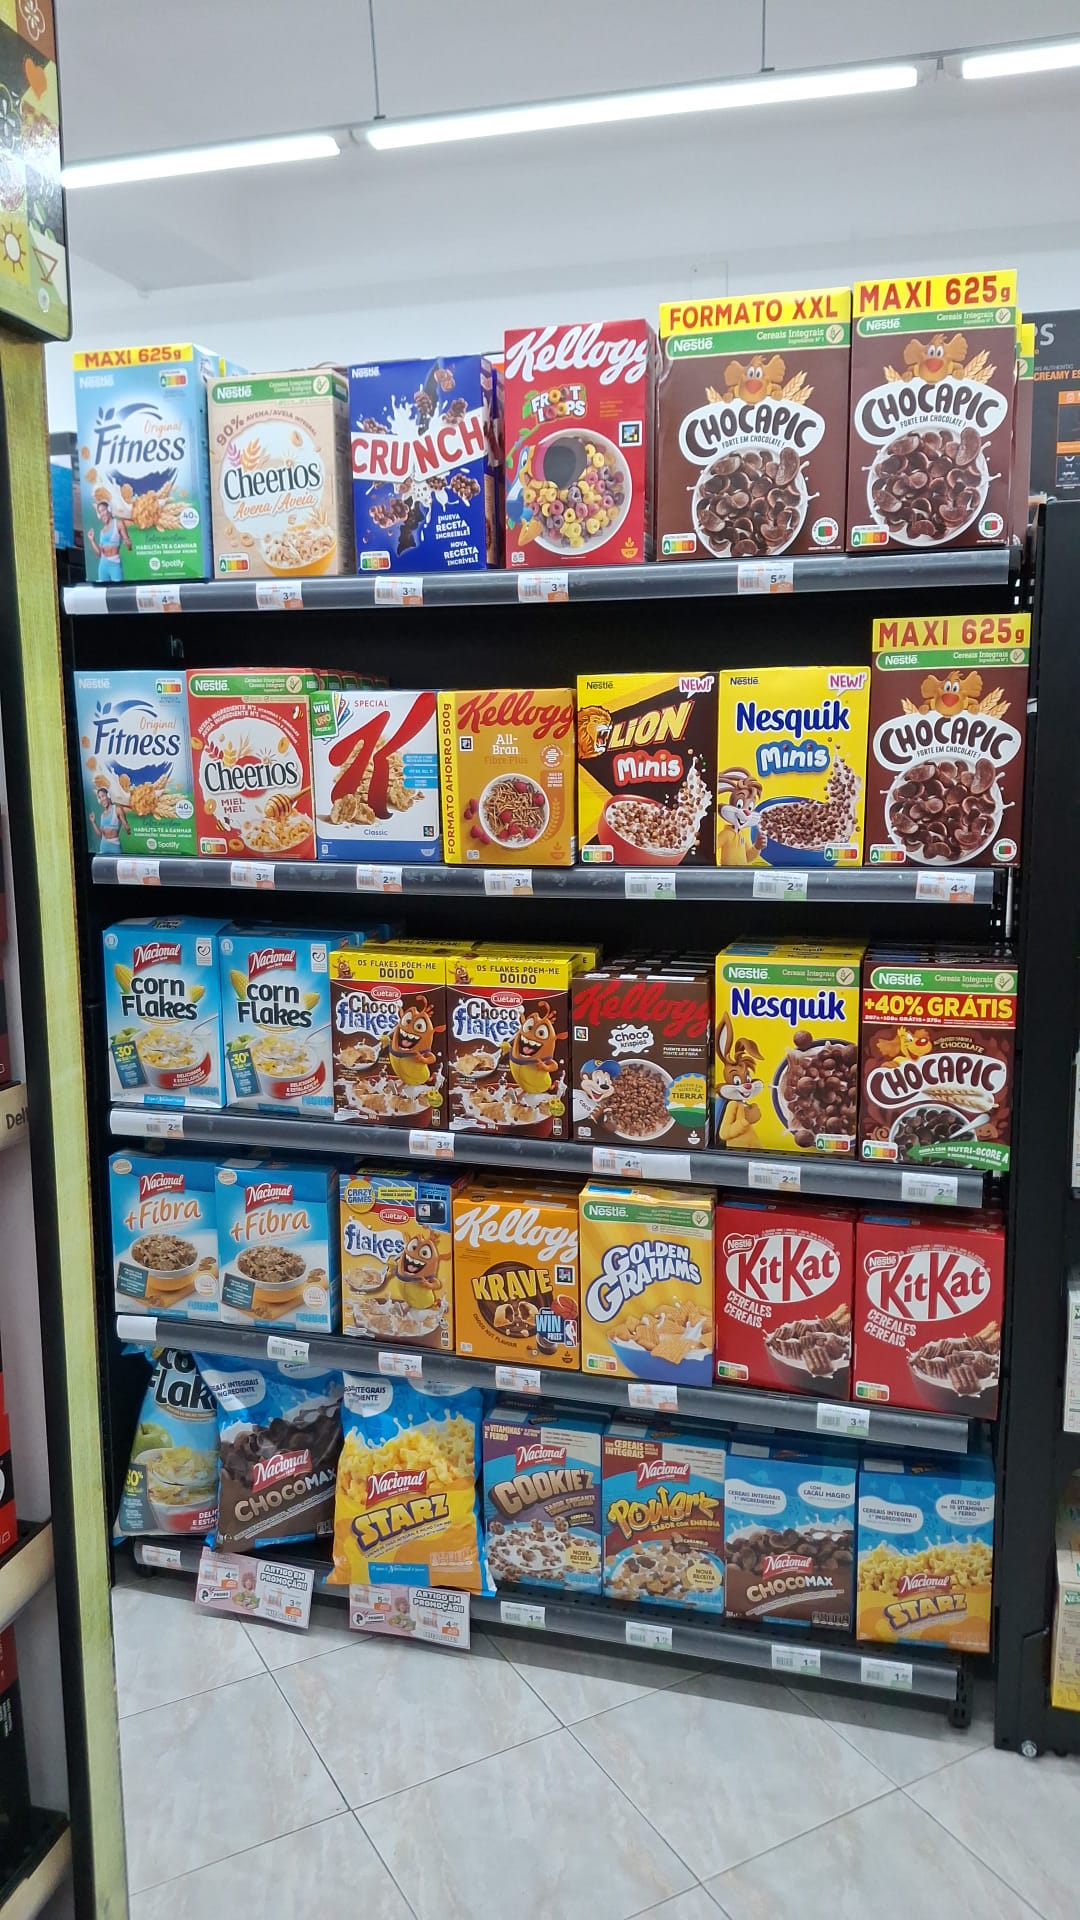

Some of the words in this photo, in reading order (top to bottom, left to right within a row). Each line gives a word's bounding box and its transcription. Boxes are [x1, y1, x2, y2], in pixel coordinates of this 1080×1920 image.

[860, 279, 932, 313] MAXI
[945, 275, 1011, 306] 625g
[669, 299, 783, 331] FORMATO
[792, 295, 838, 321] XXL
[756, 330, 787, 341] Cereais
[788, 327, 825, 338] Integrais
[866, 318, 900, 332] Nestlé
[673, 337, 713, 353] Nestlé
[84, 352, 132, 368] MAXI
[138, 346, 182, 362] 625g
[1034, 370, 1070, 381] CREAMY
[861, 383, 1000, 438] CHOCAPIC
[919, 415, 929, 423] EM
[144, 419, 182, 438] Original
[216, 415, 245, 446] 90%
[685, 403, 818, 458] CHOCAPIC
[94, 423, 186, 466] Fitness
[350, 414, 486, 477] CRUNCH
[721, 437, 739, 449] FORTE
[739, 436, 749, 444] EM
[223, 462, 321, 501] Cheerios
[436, 519, 468, 532] RECETA
[444, 546, 480, 559] RECEITA
[450, 540, 468, 548] NOVA
[160, 557, 184, 569] Spotify
[878, 619, 949, 648] MAXI
[962, 617, 1026, 645] 625g
[885, 654, 919, 666] Nestlé
[195, 680, 229, 692] Nestlé
[586, 681, 614, 690] Nestlé
[680, 677, 713, 692] NEW!
[730, 675, 760, 686] Nestlé
[829, 674, 864, 689] NEW!
[312, 703, 331, 714] WIN
[354, 699, 389, 708] SPECIAL
[139, 715, 177, 733] Original
[442, 703, 452, 735] 500g
[609, 700, 694, 751] LION
[735, 700, 851, 739] Nesquik
[93, 717, 181, 756] Fitness
[496, 733, 518, 745] All-
[879, 716, 1013, 764] CHOCAPIC
[492, 744, 519, 755] Bran
[759, 744, 829, 772] Minis
[916, 748, 934, 758] FORTE
[442, 738, 453, 792] AHORRO
[616, 752, 681, 782] Minis
[204, 761, 298, 792] Cheerios
[220, 797, 246, 807] MIEL
[223, 804, 246, 814] MEL
[363, 828, 389, 837] Classic
[443, 793, 455, 855] FORMATO
[157, 841, 180, 850] Spotify
[134, 942, 181, 967] Nacional
[249, 948, 296, 973] Nacional
[357, 959, 368, 967] OS
[370, 959, 399, 968] FLAKES
[379, 967, 415, 980] DOIDO
[476, 964, 487, 972] OS
[490, 965, 520, 973] FLAKES
[728, 966, 770, 980] Nestlé
[130, 976, 186, 997] corn
[500, 973, 537, 985] DOIDO
[878, 973, 923, 986] Nestlé
[246, 983, 300, 1004] corn
[121, 995, 199, 1021] Flakes
[237, 1001, 313, 1029] Flakes
[349, 995, 397, 1015] Choco
[466, 1000, 519, 1021] Choco
[730, 987, 846, 1026] Nesquik
[864, 994, 924, 1016] +40%
[927, 995, 1013, 1019] GRÁTIS
[337, 1000, 399, 1036] flakes
[454, 1006, 521, 1042] flakes
[614, 1029, 650, 1042] choco
[940, 1043, 985, 1054] CHOCOLATE
[869, 1055, 1003, 1105] CHOCAPIC
[672, 1092, 704, 1100] TIERRA
[947, 1146, 1002, 1161] NUTRI-SCORE
[1001, 1152, 1009, 1164] A
[141, 1172, 184, 1196] Nacional
[347, 1187, 373, 1197] CRAZY
[246, 1183, 293, 1207] Nacional
[347, 1195, 373, 1205] GAMES
[125, 1198, 201, 1231] +Fibra
[588, 1204, 629, 1219] Nestlé
[230, 1210, 311, 1242] +Fibra
[344, 1224, 405, 1259] flakes
[727, 1238, 753, 1251] Nestlé
[603, 1240, 690, 1284] GOLDEN
[737, 1236, 837, 1302] KitKat
[869, 1254, 898, 1268] Nestlé
[471, 1269, 552, 1302] KRAVE
[586, 1257, 702, 1323] GRAHAMS
[880, 1251, 986, 1320] KitKat
[727, 1290, 772, 1319] CEREALES
[535, 1314, 562, 1332] WIN
[723, 1302, 763, 1330] CEREAIS
[867, 1308, 917, 1337] CEREALES
[863, 1321, 907, 1349] CEREAIS
[228, 1379, 259, 1388] INTEGRAIS
[489, 1432, 509, 1441] FERRO
[614, 1439, 644, 1451] CEREAIS
[516, 1443, 566, 1466] Nacional
[605, 1446, 645, 1459] INTEGRAIS
[254, 1449, 309, 1480] Nacional
[638, 1459, 689, 1483] Nacional
[367, 1470, 427, 1500] Nacional
[728, 1489, 751, 1498] CEREAIS
[751, 1492, 781, 1501] INTEGRAIS
[803, 1489, 824, 1497] CACAU
[825, 1491, 851, 1500] MAGRO
[234, 1468, 337, 1523] CHOCOMAX
[740, 1497, 775, 1506] INGREDIENTE
[352, 1493, 450, 1552] STARZ
[862, 1507, 886, 1515] CEREAIS
[886, 1509, 918, 1519] INTEGRAIS
[875, 1515, 912, 1524] INGREDIENTE
[653, 1522, 676, 1532] SABOR
[264, 1564, 293, 1579] ARTIGO
[293, 1571, 306, 1581] EM
[764, 1554, 813, 1575] Nacional
[746, 1576, 834, 1603] CHOCOMAX
[899, 1573, 951, 1595] Nacional
[416, 1589, 447, 1601] ARTIGO
[447, 1594, 462, 1603] EM
[884, 1592, 968, 1631] STARZ
